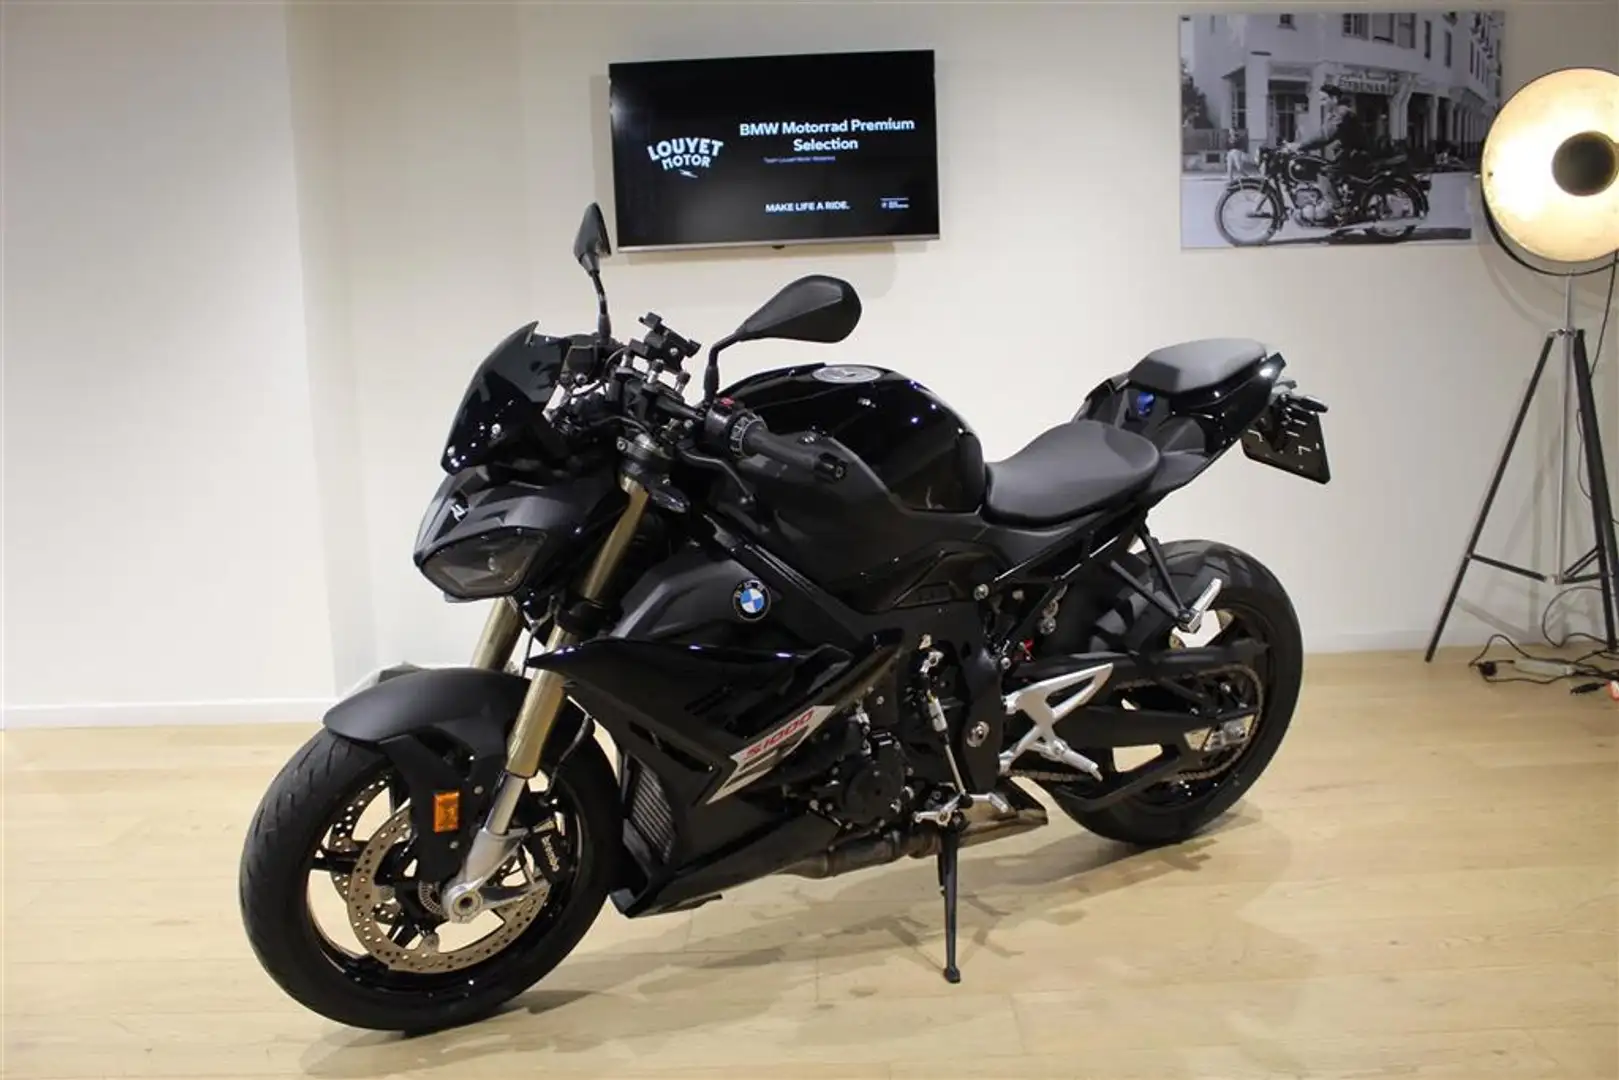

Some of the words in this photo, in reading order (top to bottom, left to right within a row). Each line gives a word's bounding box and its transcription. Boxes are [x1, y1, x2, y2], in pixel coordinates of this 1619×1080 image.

[739, 122, 779, 137] BMW
[782, 119, 848, 135] Motorrad
[851, 117, 915, 132] Premium
[647, 137, 724, 161] LOUYET
[793, 138, 858, 152] Selection
[662, 154, 711, 170] MOTOR
[765, 203, 794, 212] MAKE
[795, 202, 815, 212] LIFE
[816, 202, 824, 211] A
[742, 711, 814, 759] S1000
